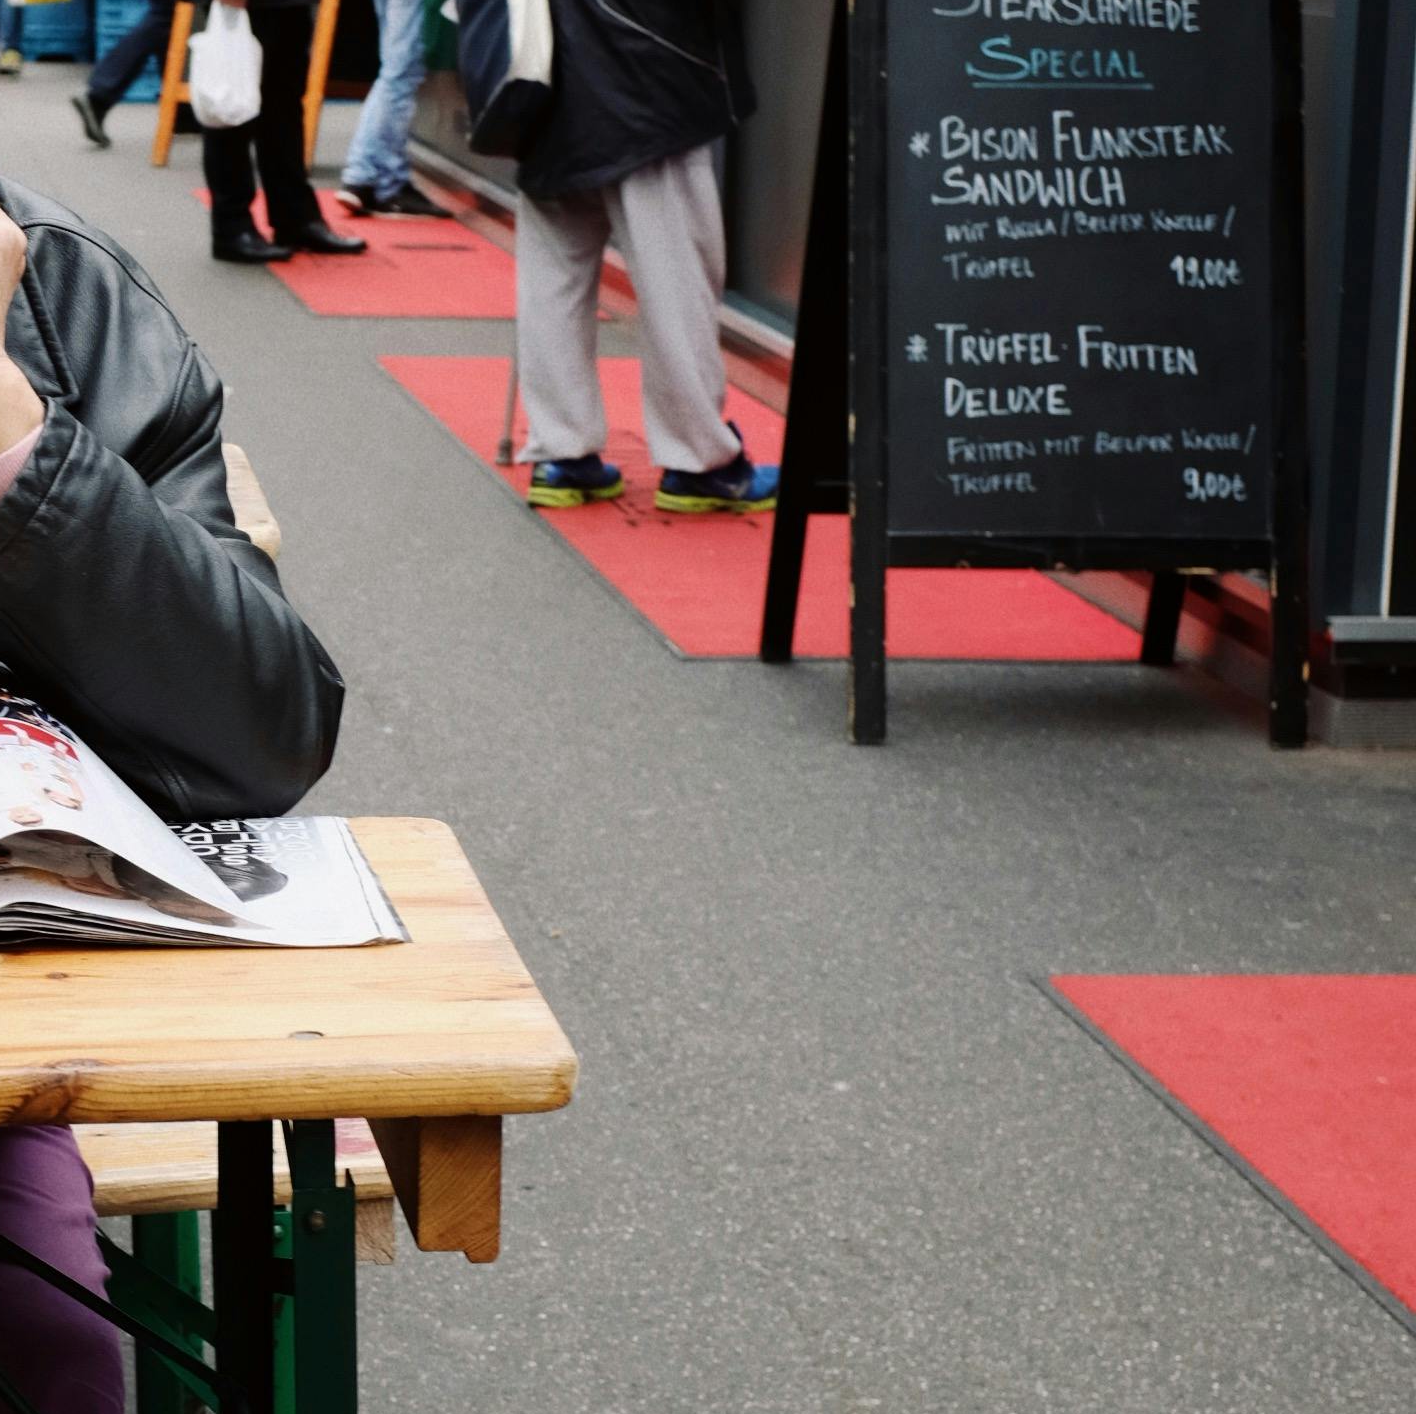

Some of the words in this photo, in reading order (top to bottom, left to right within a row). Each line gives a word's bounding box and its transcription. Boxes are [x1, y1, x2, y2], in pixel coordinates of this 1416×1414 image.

[965, 35, 1145, 80] SPECIAL
[939, 115, 1039, 162] BISON
[1051, 109, 1234, 162] FLANKSTEAK
[931, 164, 1127, 208] SANDWICH
[1077, 324, 1199, 375] FRITTEN
[944, 377, 1073, 418] DELUXE
